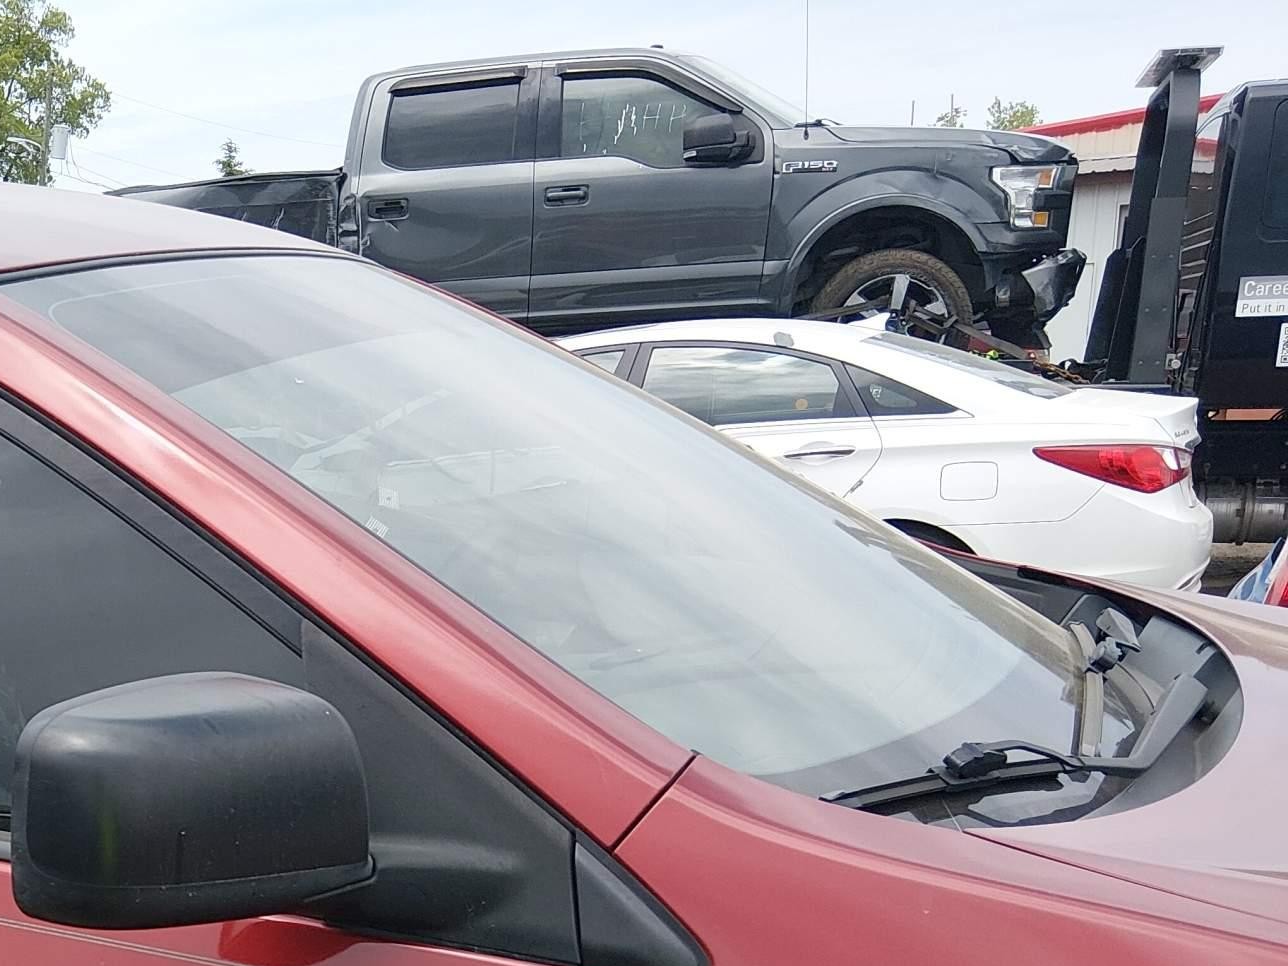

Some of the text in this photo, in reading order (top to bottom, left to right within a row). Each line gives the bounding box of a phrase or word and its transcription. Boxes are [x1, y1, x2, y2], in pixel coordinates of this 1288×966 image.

[1241, 302, 1285, 314] Put it in
